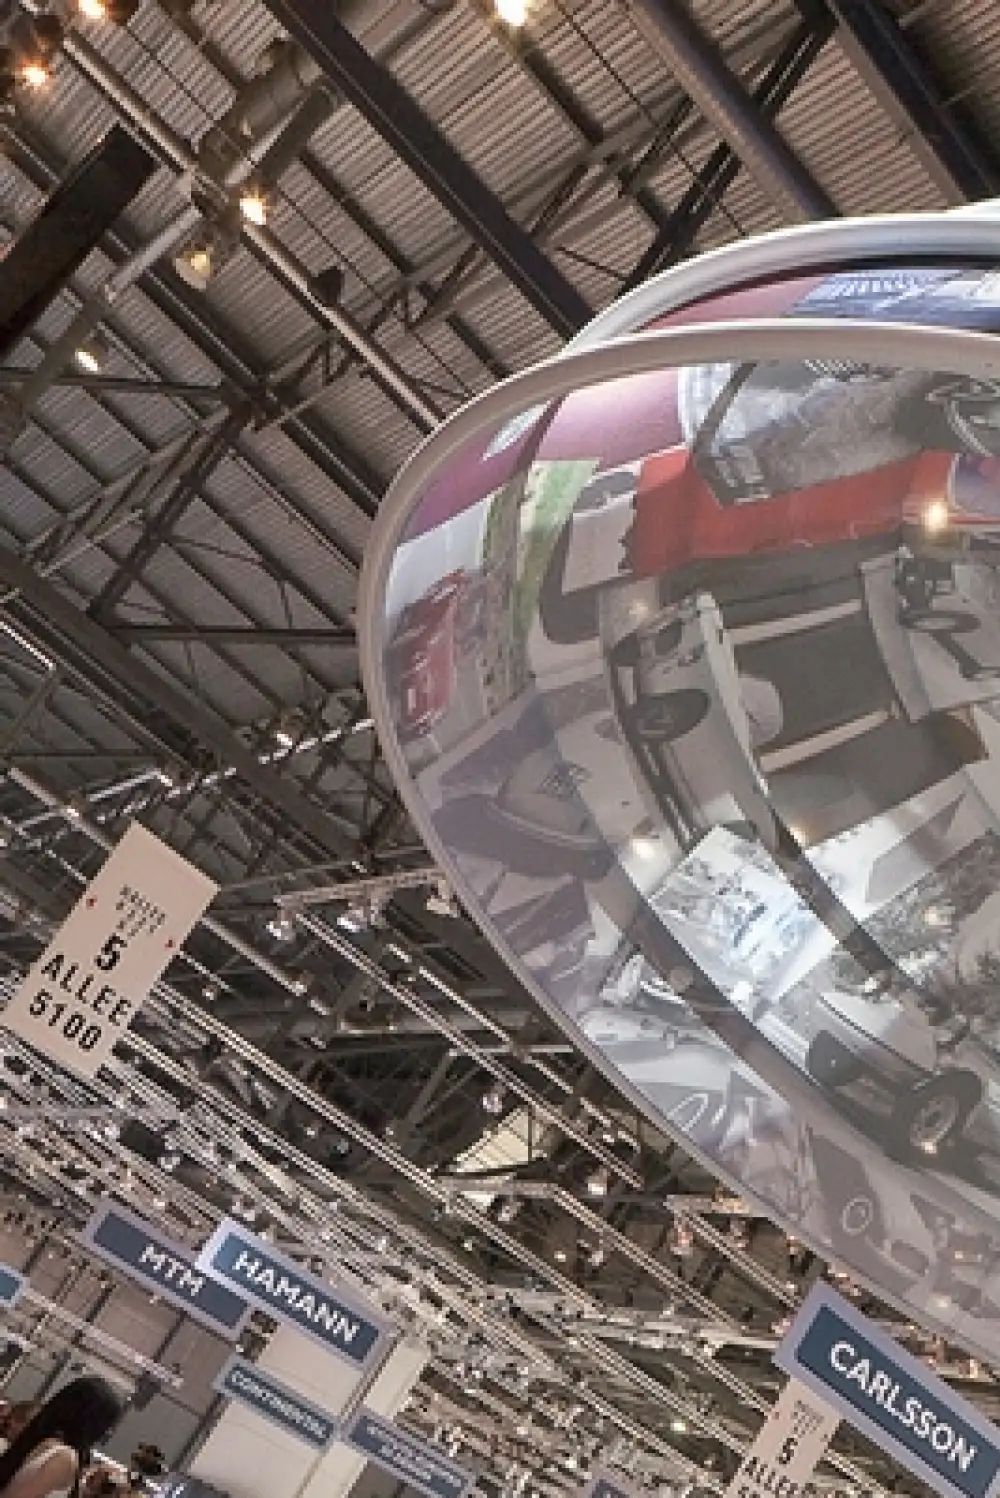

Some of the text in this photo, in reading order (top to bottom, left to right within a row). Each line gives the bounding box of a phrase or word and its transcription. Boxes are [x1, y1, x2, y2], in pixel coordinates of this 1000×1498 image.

[96, 935, 124, 971] 5
[29, 987, 101, 1051] 5100
[41, 953, 132, 1026] ALLEE
[140, 1246, 203, 1296] MTM
[232, 1252, 358, 1342] HAMANN
[829, 1341, 978, 1473] CARLSSON
[774, 1437, 796, 1466] 5
